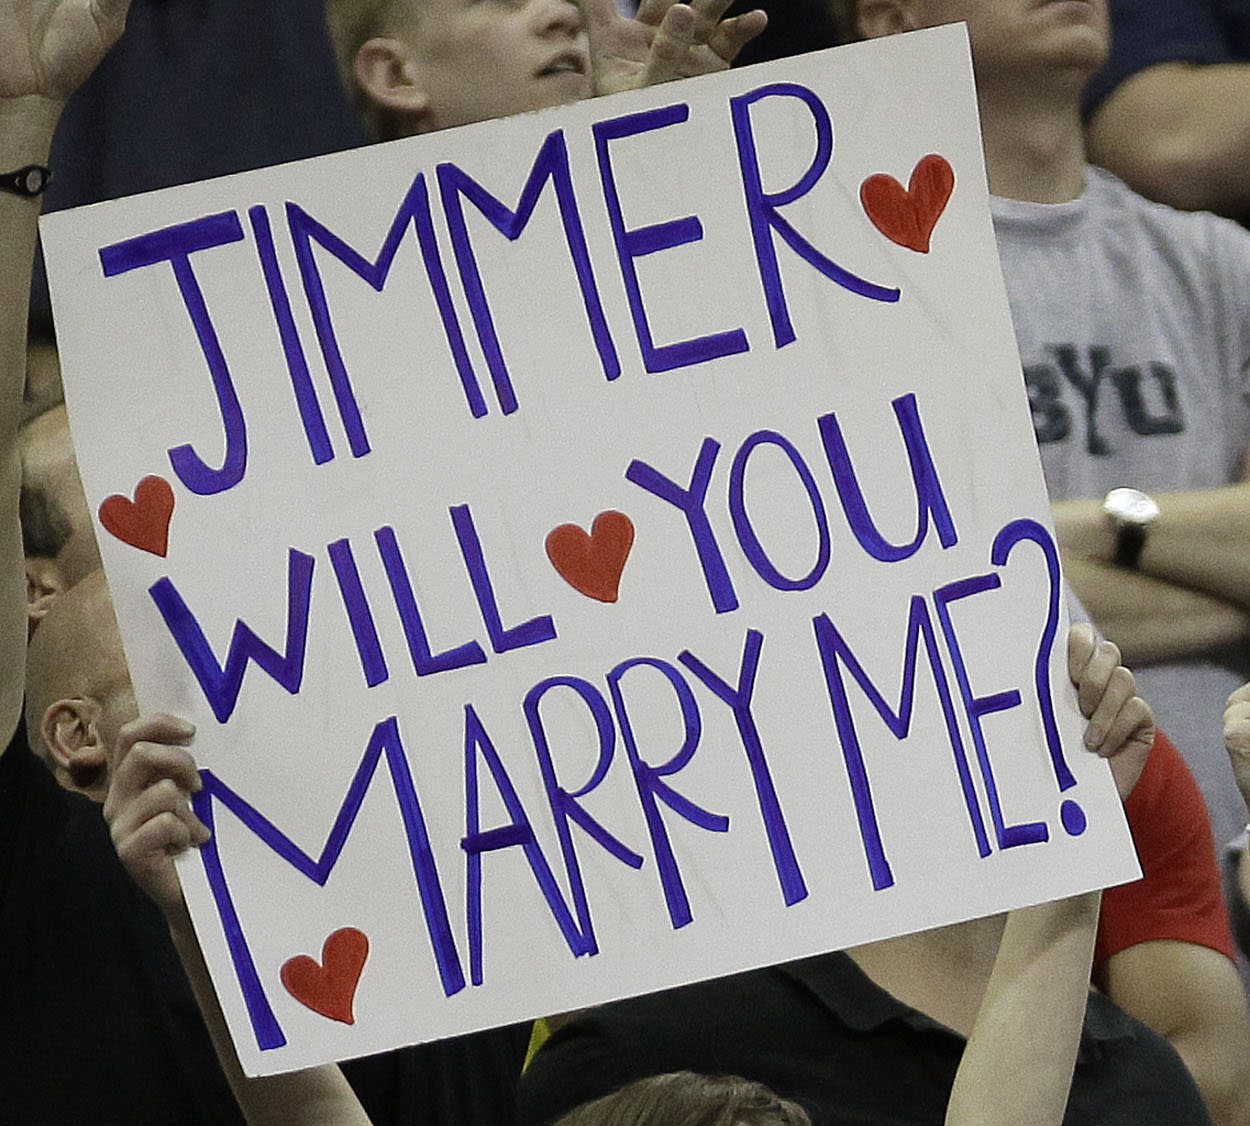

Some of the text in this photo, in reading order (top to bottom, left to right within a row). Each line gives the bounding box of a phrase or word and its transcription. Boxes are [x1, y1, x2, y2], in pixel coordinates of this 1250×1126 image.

[100, 84, 900, 497] JIMMER
[1023, 342, 1186, 456] BYU
[149, 394, 957, 724] WILL YOU
[193, 519, 1087, 1051] MARRY ME?
